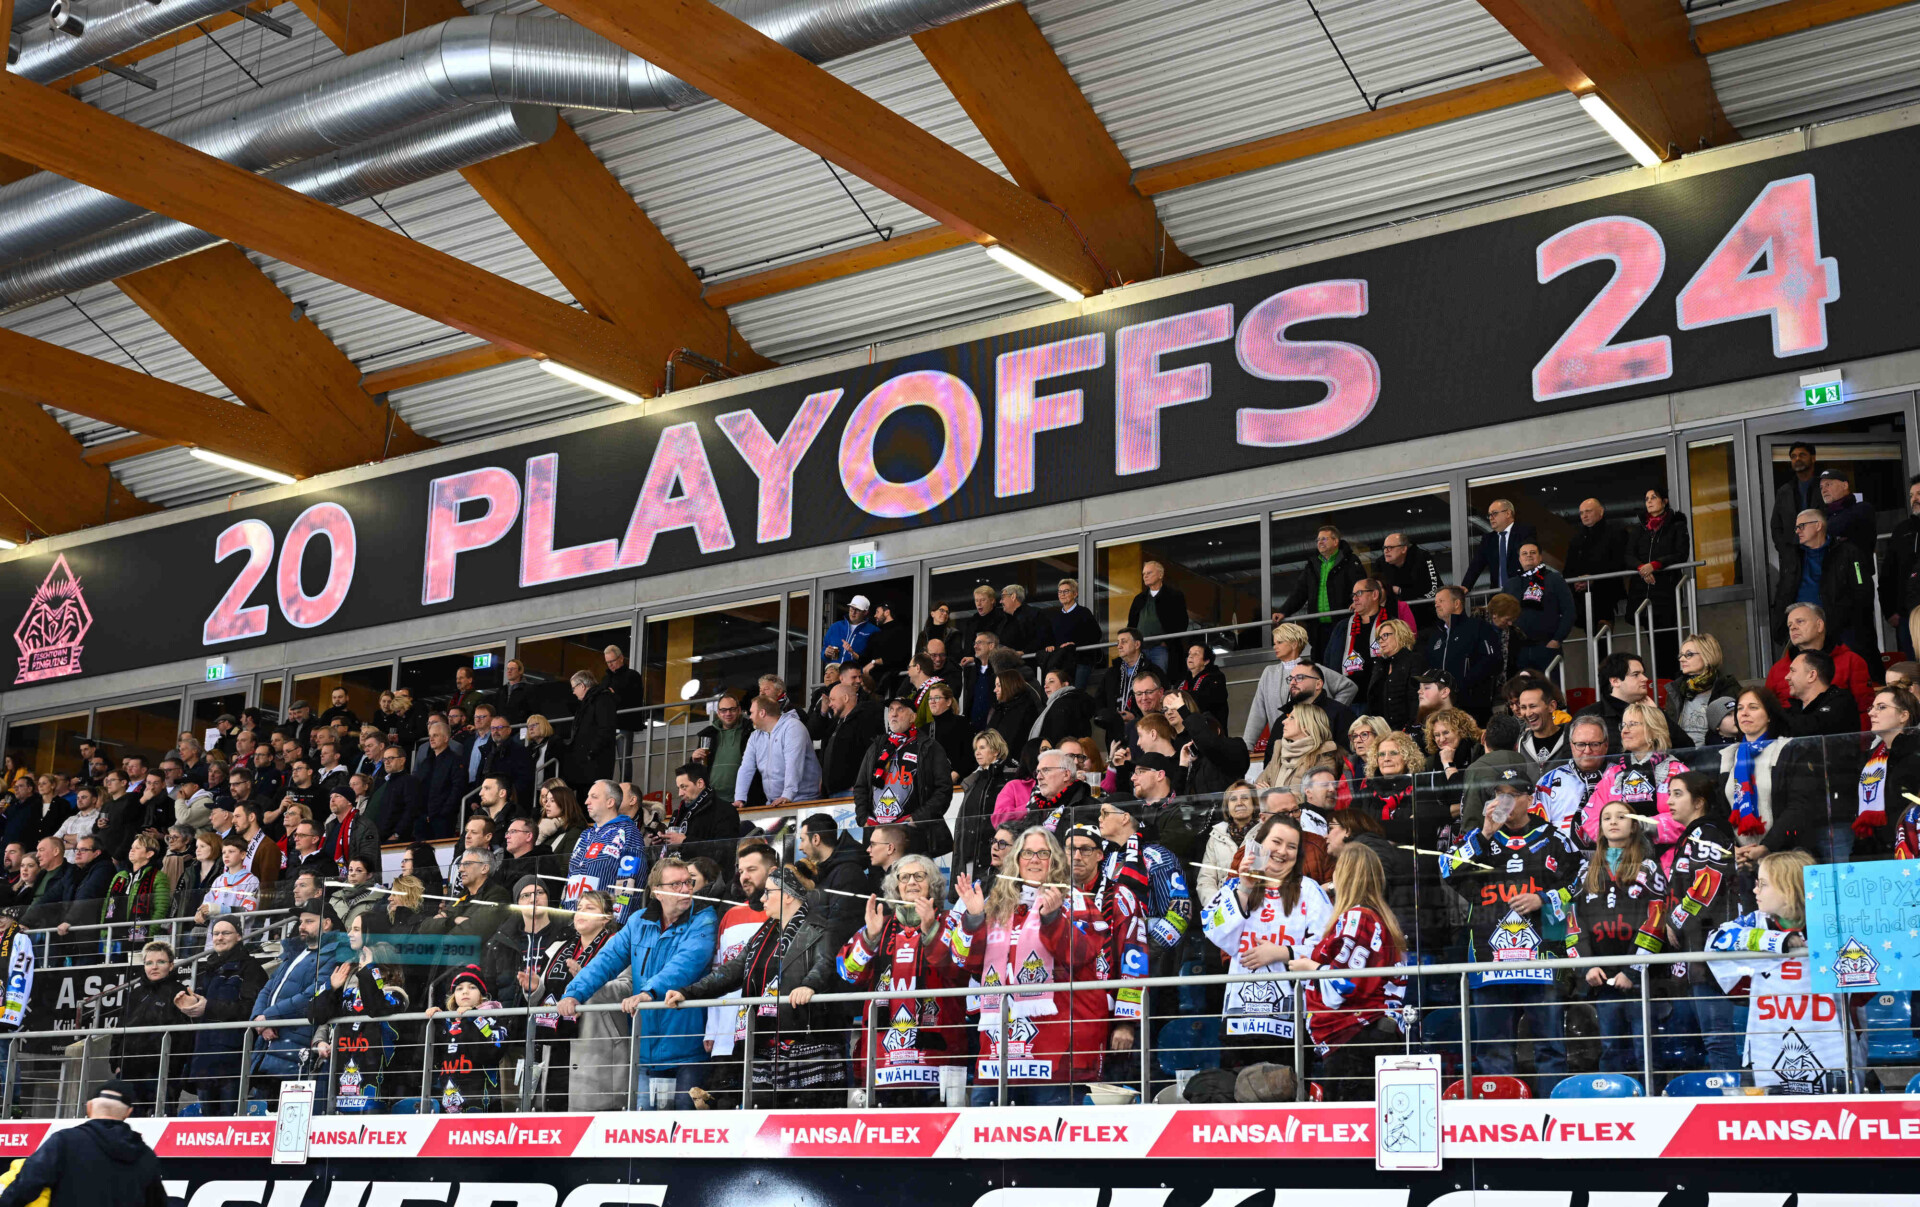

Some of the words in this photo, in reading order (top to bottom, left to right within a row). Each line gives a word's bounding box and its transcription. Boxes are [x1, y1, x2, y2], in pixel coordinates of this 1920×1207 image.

[203, 502, 356, 645] 20
[421, 279, 1381, 606] PLAYOFFS
[1532, 173, 1840, 402] 24
[885, 766, 913, 785] wb
[1697, 840, 1722, 861] 55
[567, 877, 593, 899] wb
[1819, 872, 1913, 906] Happy
[1882, 996, 1893, 1004] 14
[1243, 1019, 1292, 1036] WÄHLER
[441, 1054, 474, 1076] wb
[885, 1067, 940, 1082] WÄHLER
[991, 1064, 1050, 1077] WHLER
